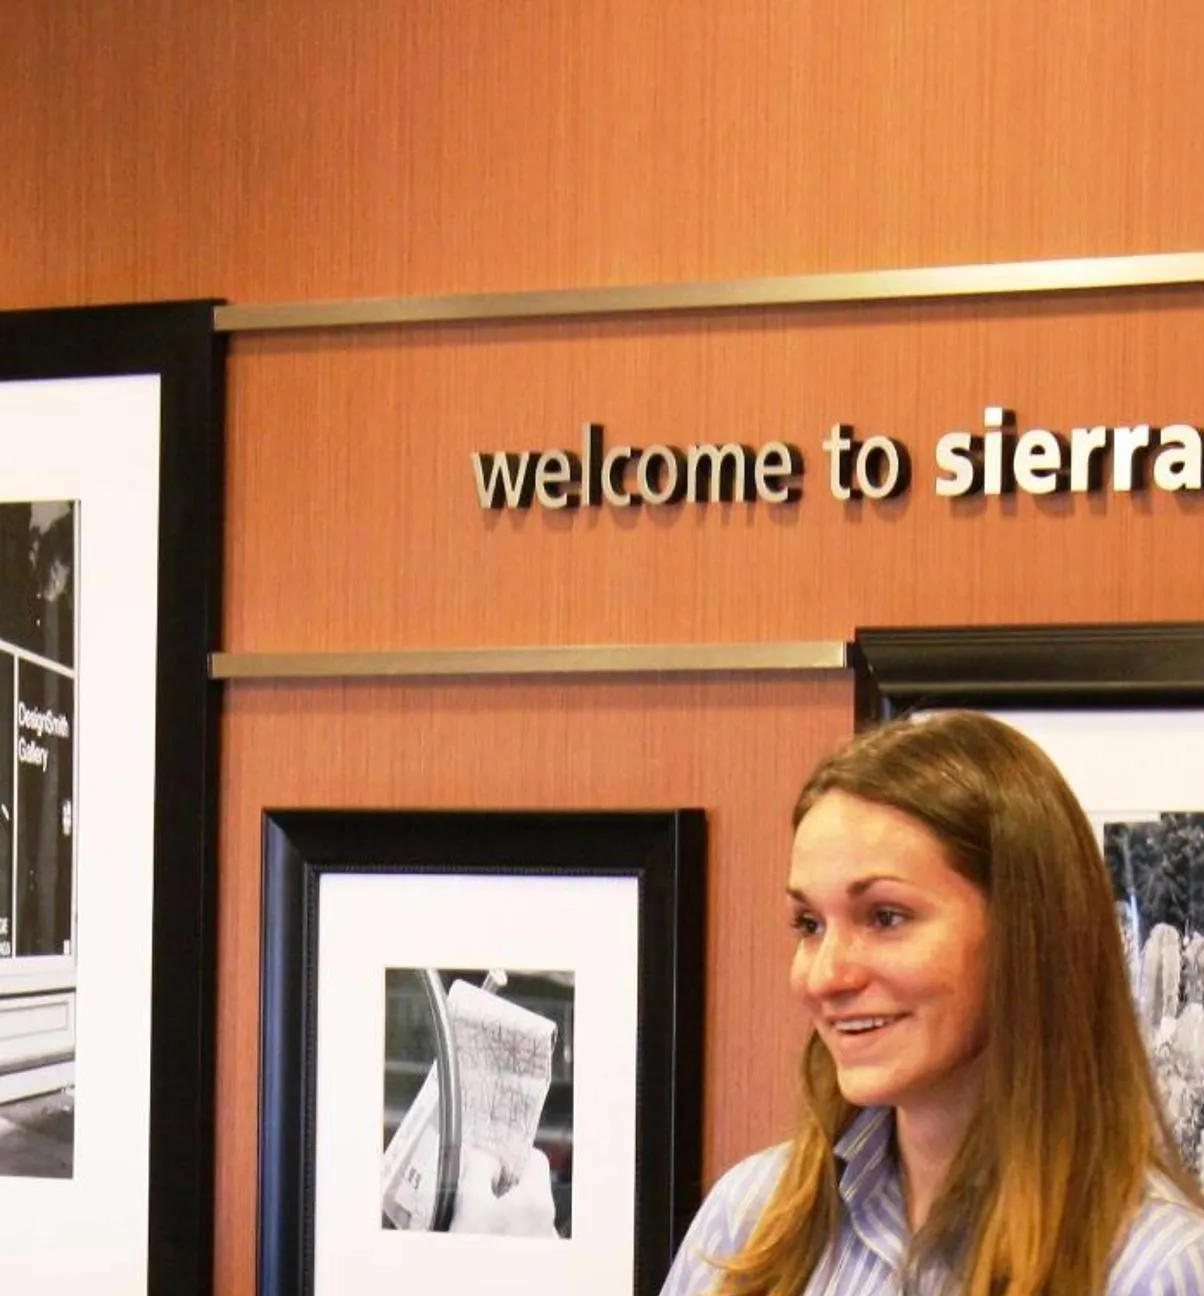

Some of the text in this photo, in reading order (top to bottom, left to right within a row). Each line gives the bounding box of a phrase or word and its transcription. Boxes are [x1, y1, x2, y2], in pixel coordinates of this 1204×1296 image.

[470, 423, 796, 509] welcome
[822, 422, 904, 500] to
[18, 735, 49, 773] Gallery
